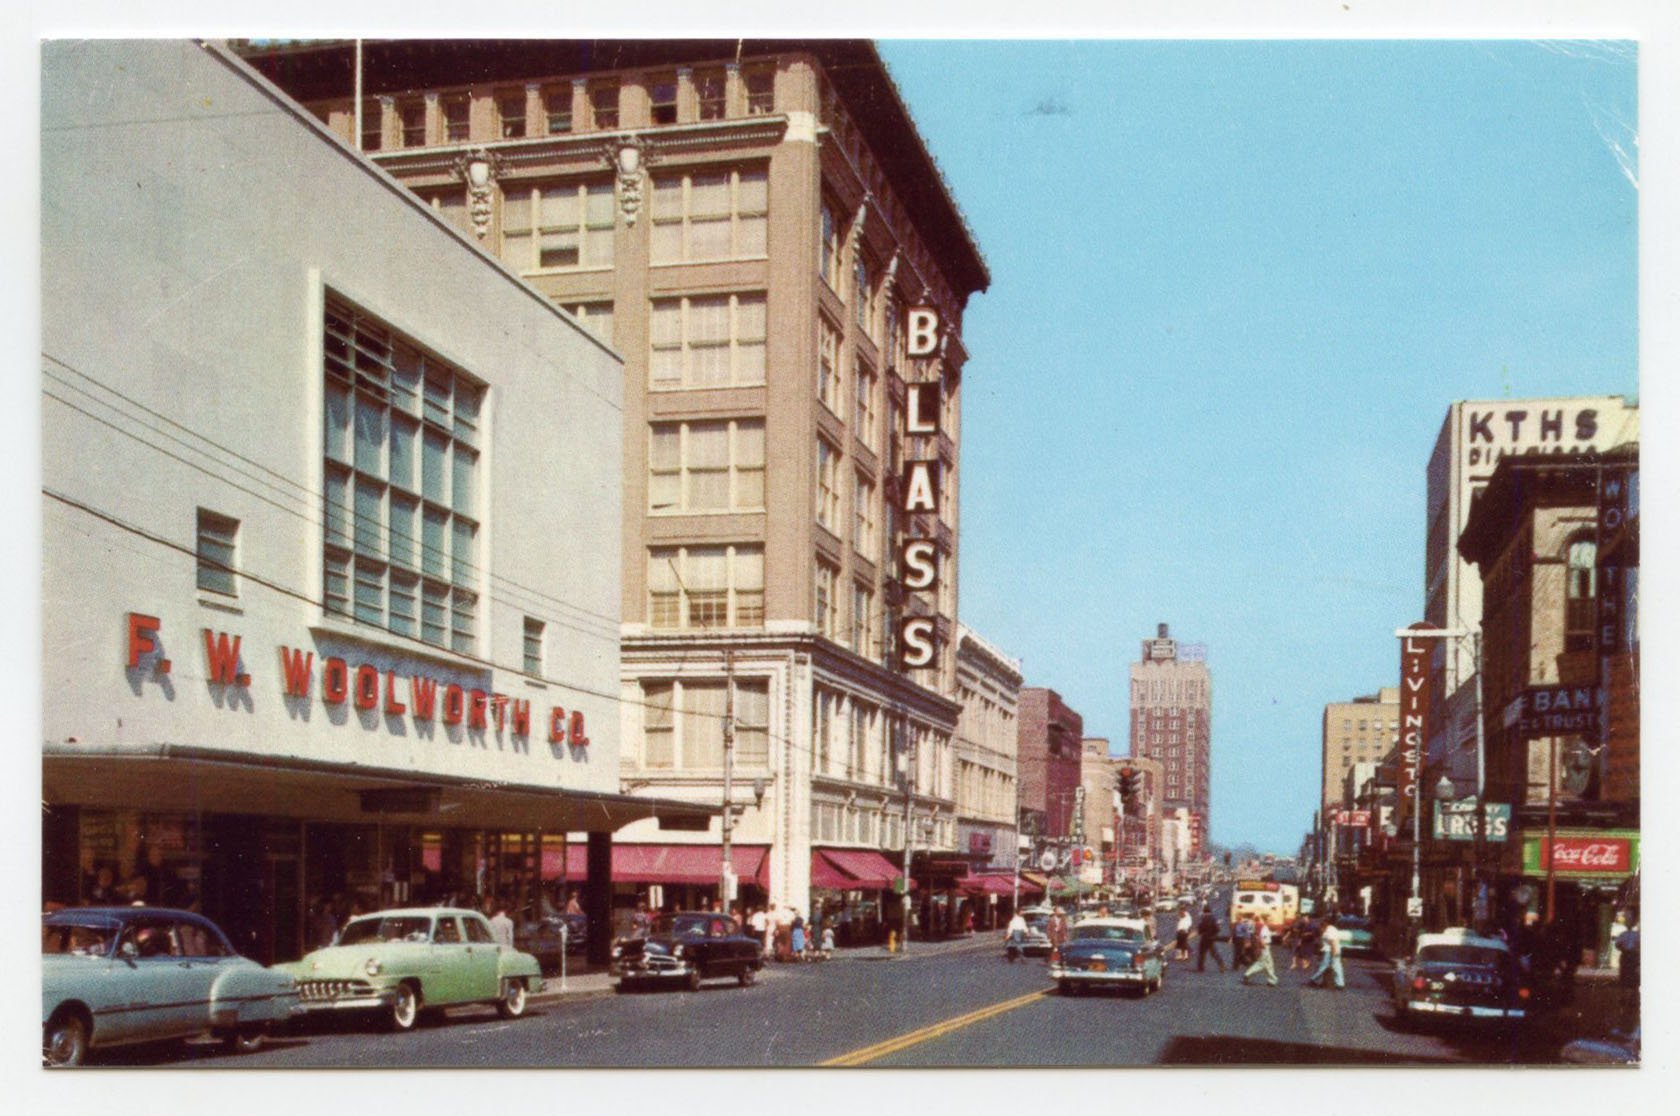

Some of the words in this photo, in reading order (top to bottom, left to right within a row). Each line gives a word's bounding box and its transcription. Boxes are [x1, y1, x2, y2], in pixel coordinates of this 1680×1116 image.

[904, 310, 937, 668] BLASS
[1470, 409, 1597, 443] KTHS
[128, 612, 172, 674] F.
[204, 628, 251, 688] W.
[281, 645, 531, 737] WOOLWORTH
[549, 706, 590, 746] CO.
